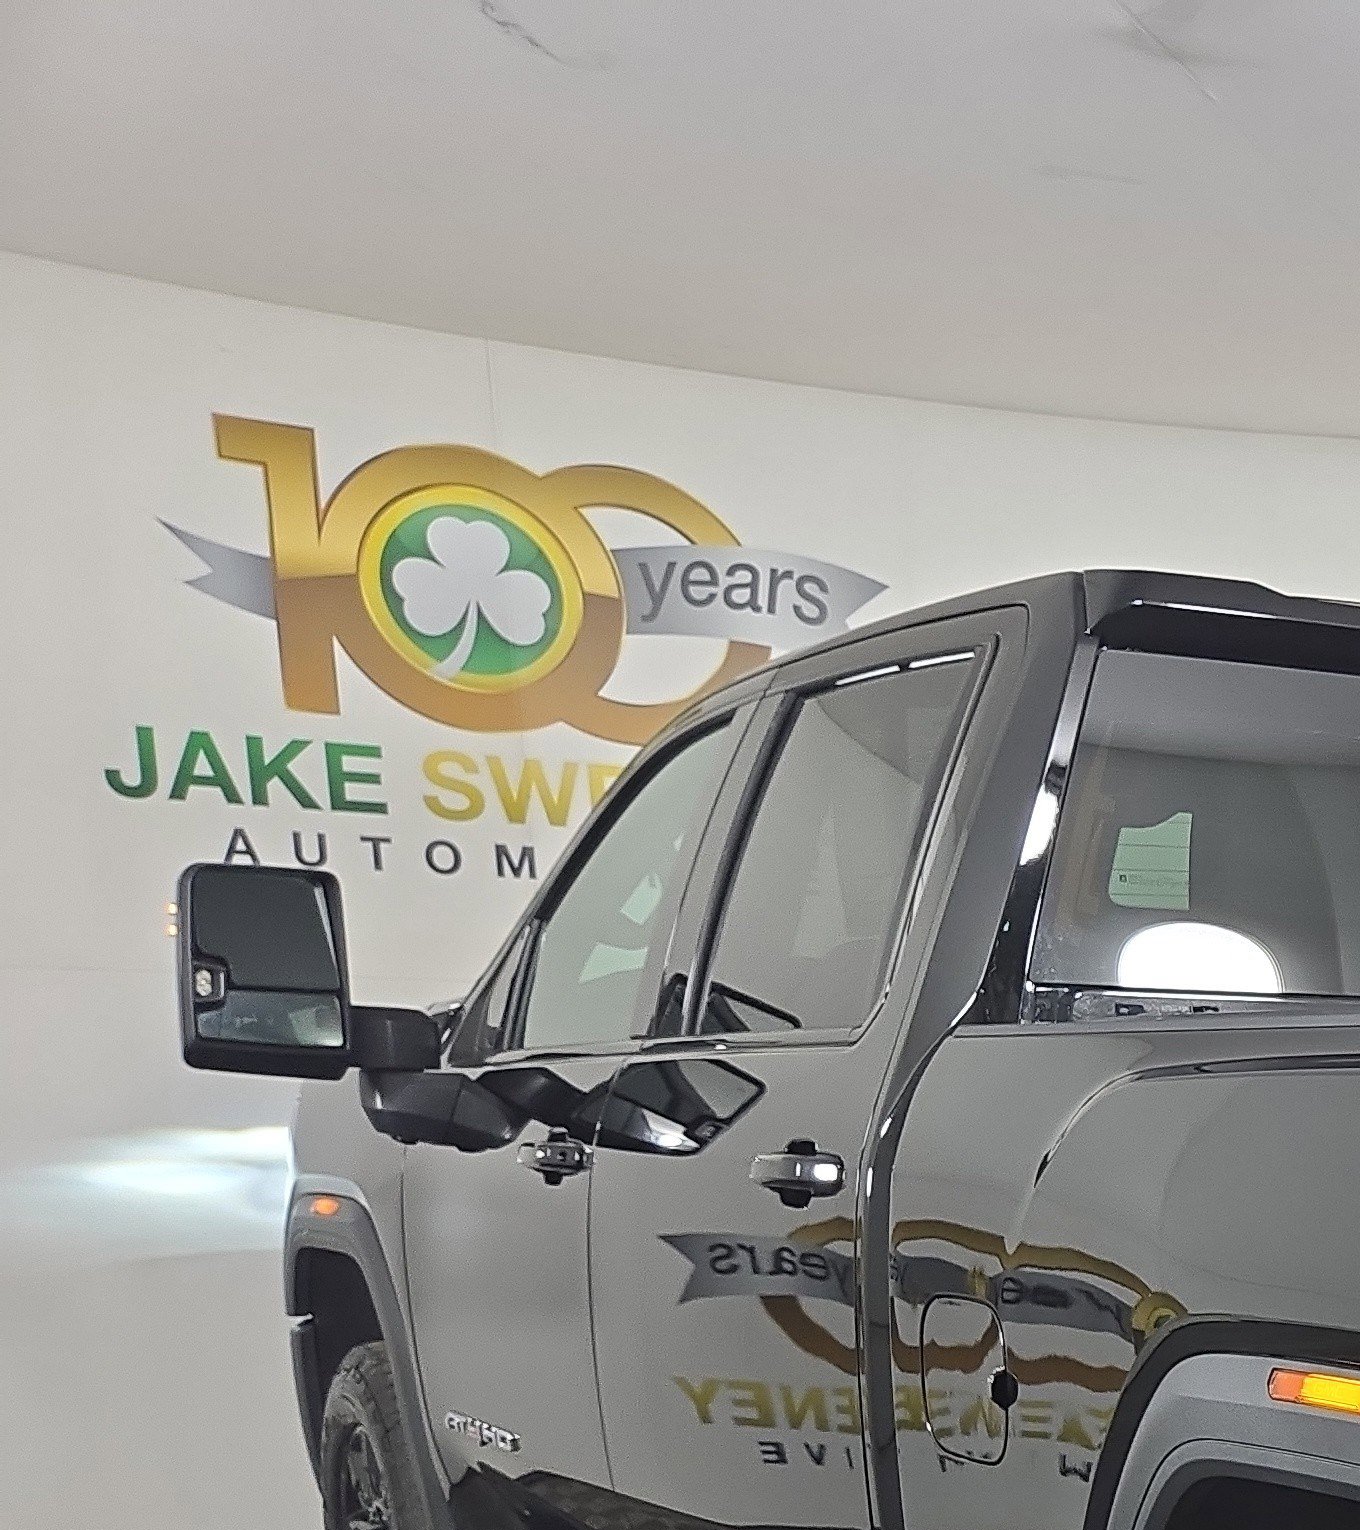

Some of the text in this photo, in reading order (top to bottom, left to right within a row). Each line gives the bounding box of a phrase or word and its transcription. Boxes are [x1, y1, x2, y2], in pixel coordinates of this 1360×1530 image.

[637, 551, 831, 626] years
[104, 725, 389, 816] JAKE
[222, 828, 537, 881] AUTOM
